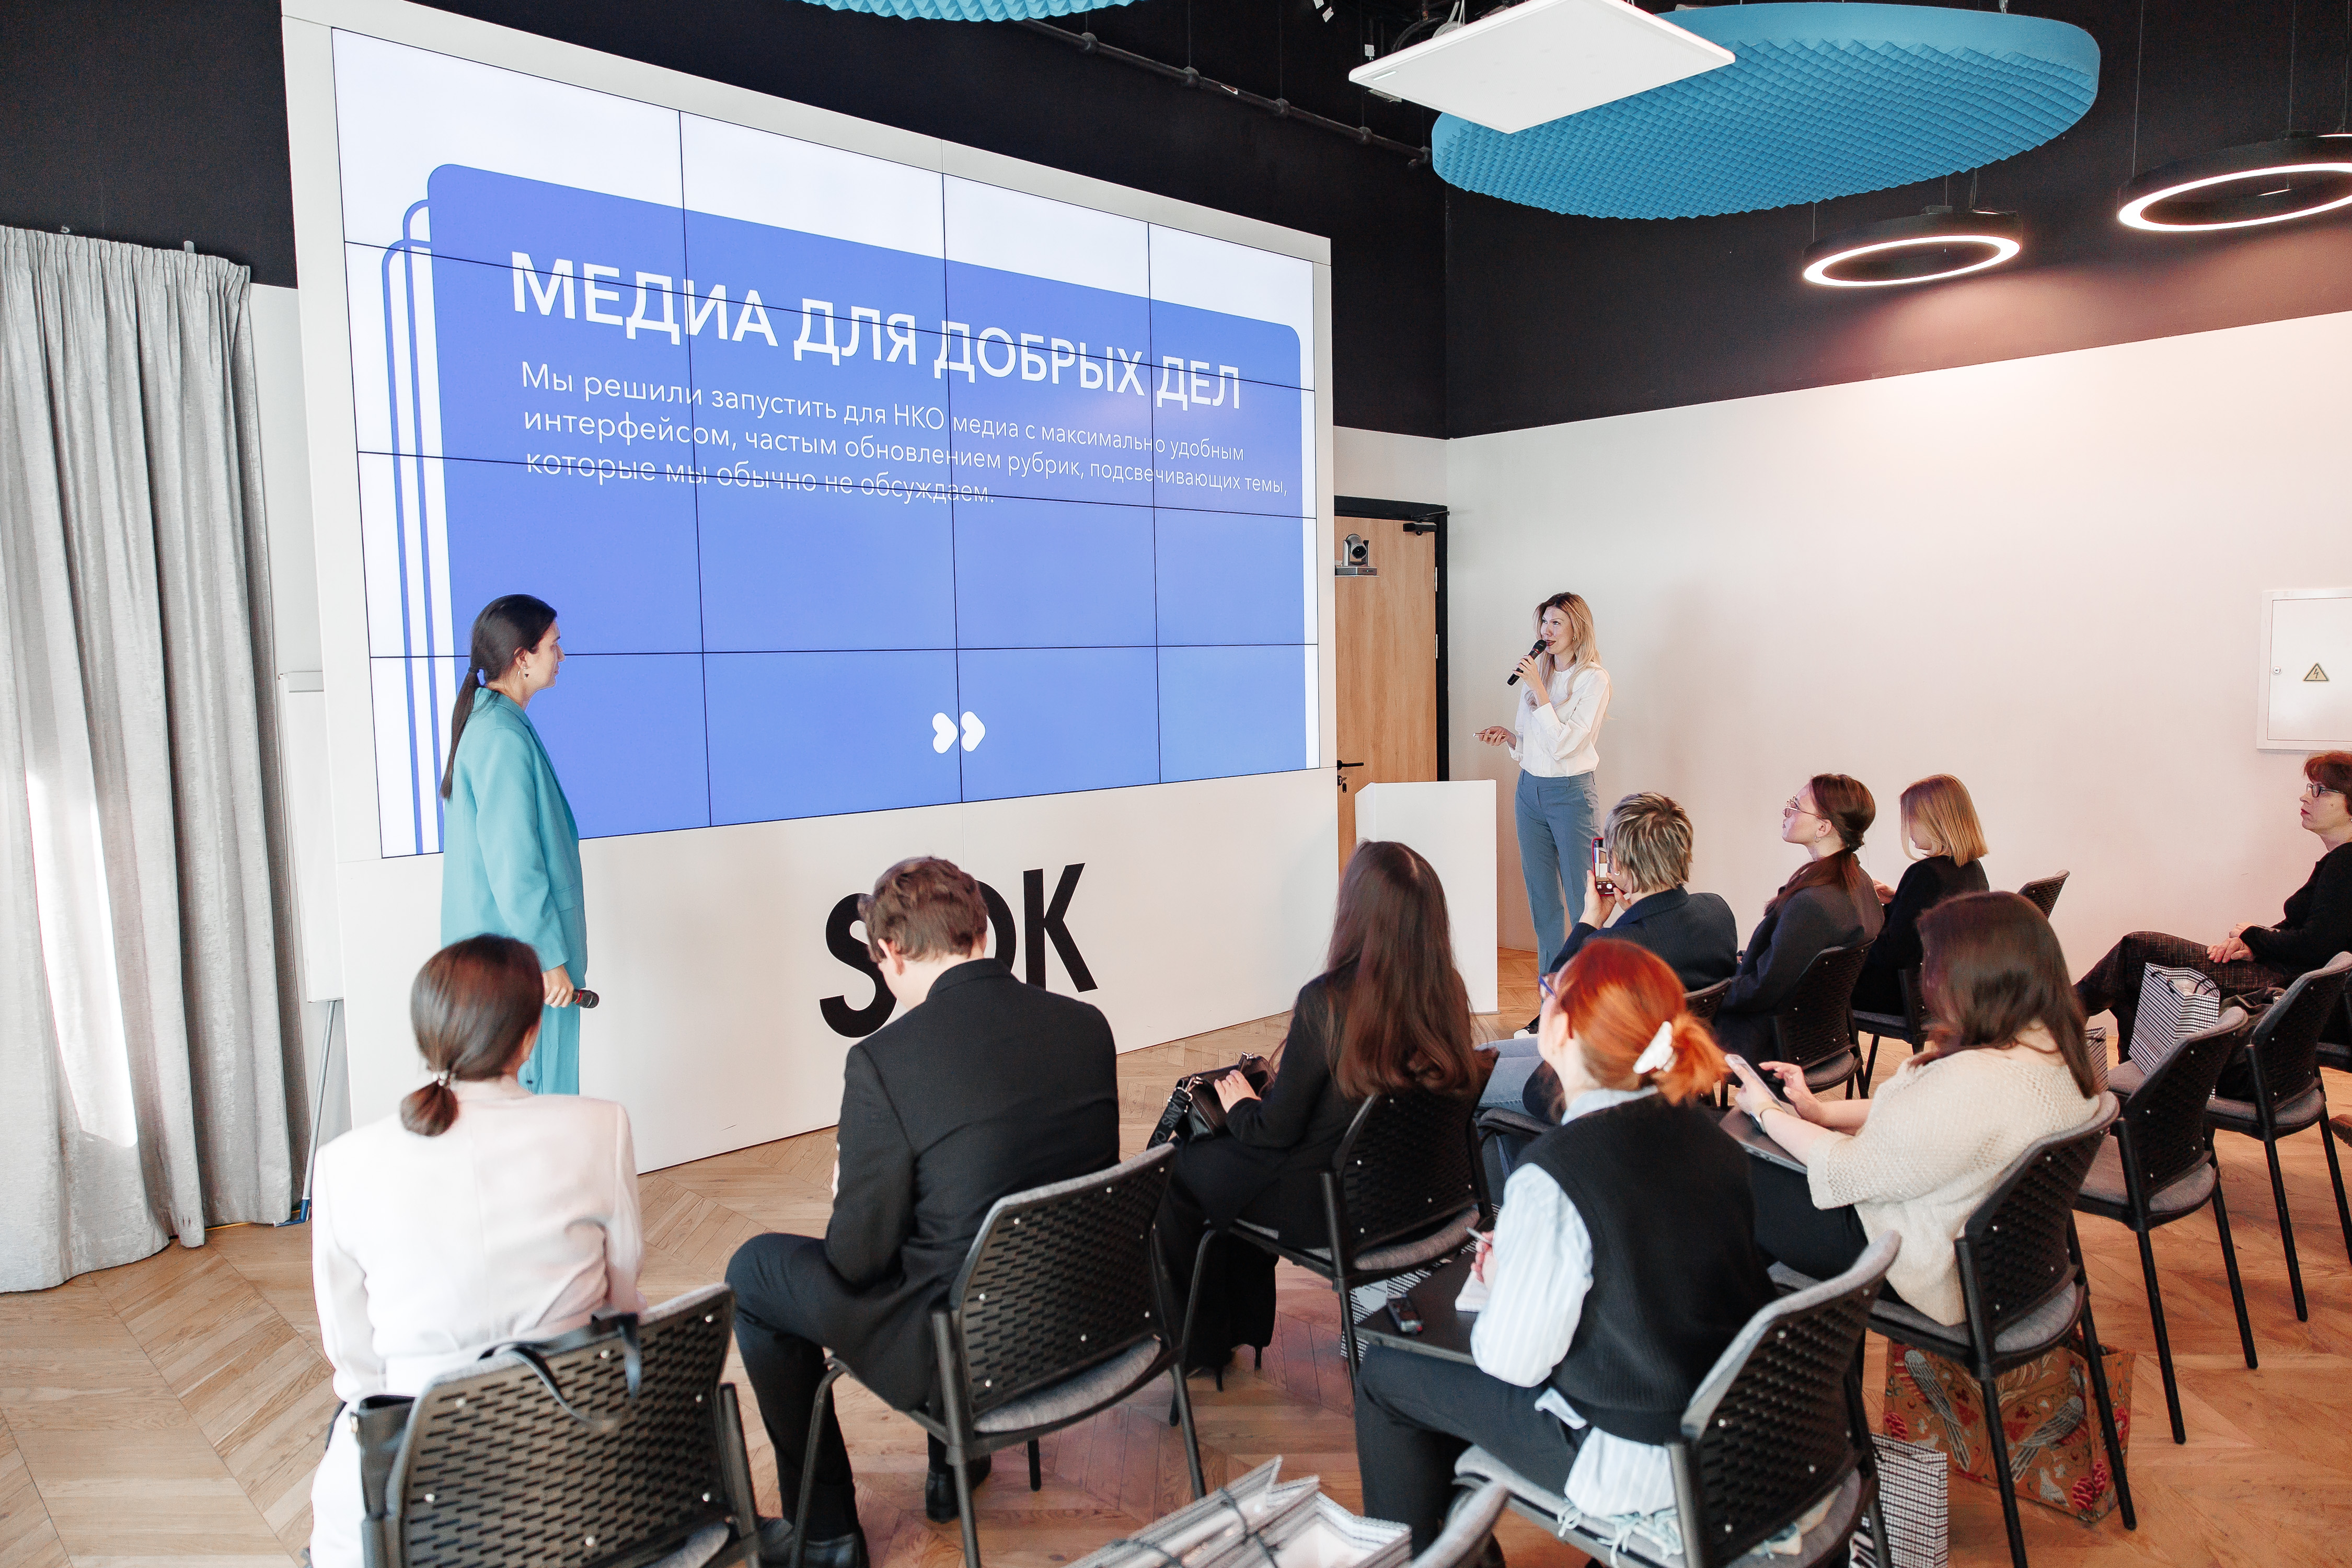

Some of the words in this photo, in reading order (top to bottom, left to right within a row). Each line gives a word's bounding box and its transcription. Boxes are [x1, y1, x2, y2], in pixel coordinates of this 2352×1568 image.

[511, 251, 779, 347] МЕДИА
[793, 297, 917, 366] ДЛЯ
[933, 320, 1145, 396] ДОБРЫХ
[1156, 355, 1240, 411] ДЕЛ
[522, 361, 573, 392] Мы
[584, 376, 702, 405] решили
[711, 390, 837, 419] запустить
[844, 405, 886, 426] для
[894, 403, 944, 430] НКО
[953, 417, 1018, 439] медиа
[1025, 424, 1035, 440] с
[1042, 426, 1166, 453] максимально
[1170, 438, 1243, 460] удобным
[524, 411, 736, 451] интерфейсом,
[745, 432, 836, 455] частым
[845, 435, 1000, 469] обновлением
[1008, 451, 1084, 479] рубрик,
[1090, 463, 1240, 491] подсвечивающих
[1244, 478, 1288, 496] темы,
[527, 453, 656, 486] которые
[666, 464, 707, 485] мы
[717, 460, 816, 492] обычно
[825, 475, 852, 494] не
[861, 471, 994, 504] обсуждаем.
